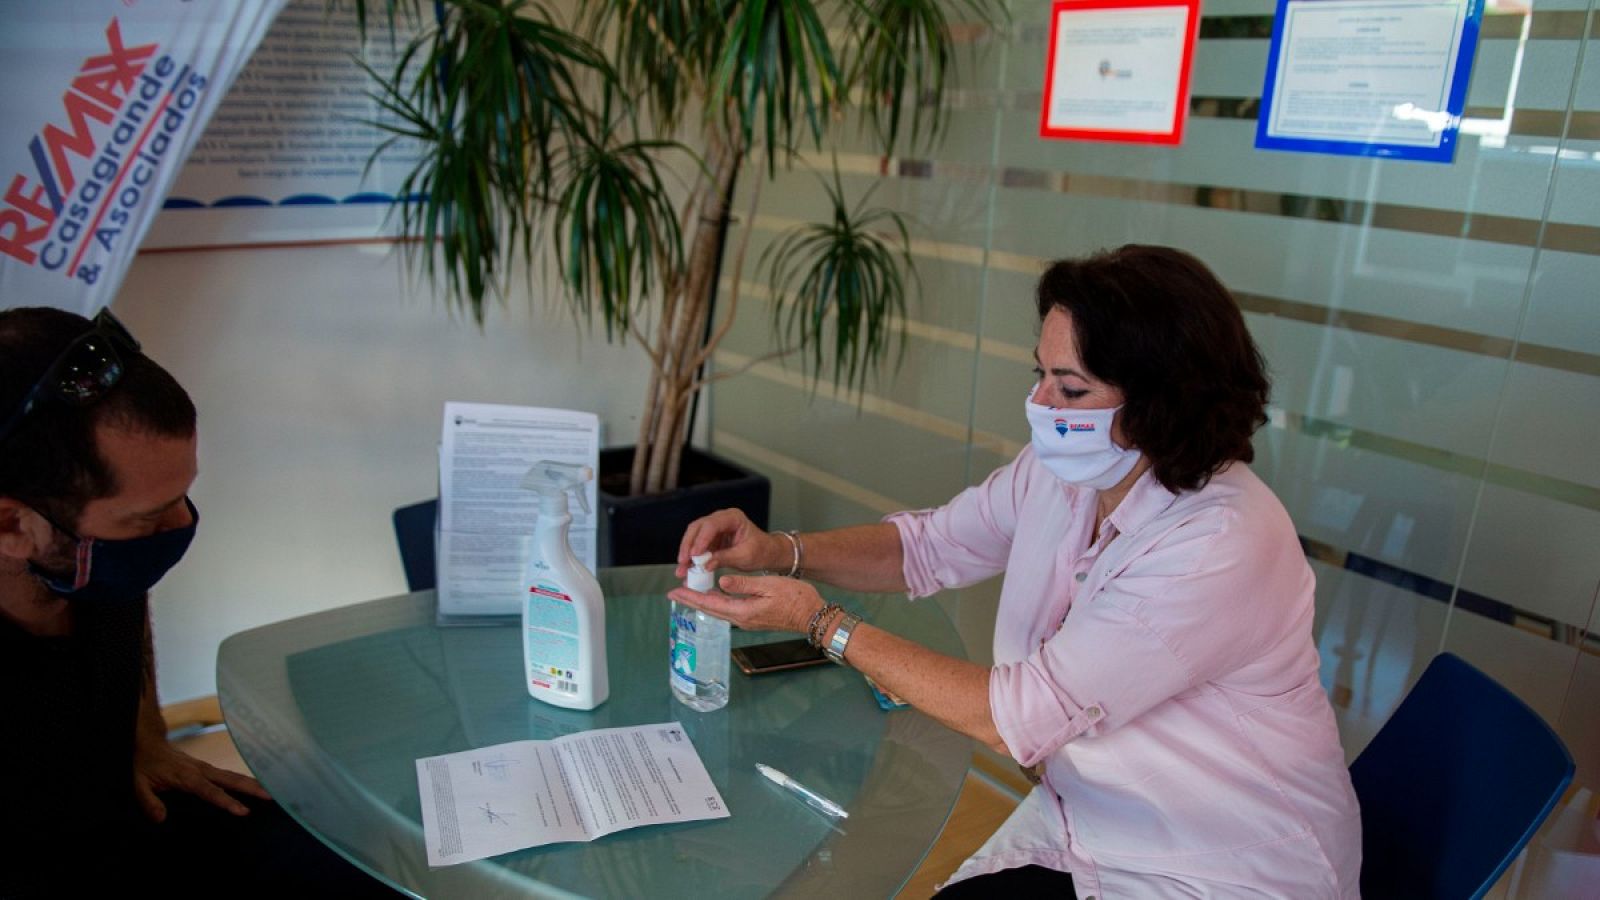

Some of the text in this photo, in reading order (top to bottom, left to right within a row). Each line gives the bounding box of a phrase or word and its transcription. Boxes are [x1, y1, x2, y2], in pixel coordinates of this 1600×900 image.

[0, 16, 160, 267] RE/MAX
[40, 54, 177, 271] Casagrande
[77, 71, 208, 286] & Asociados
